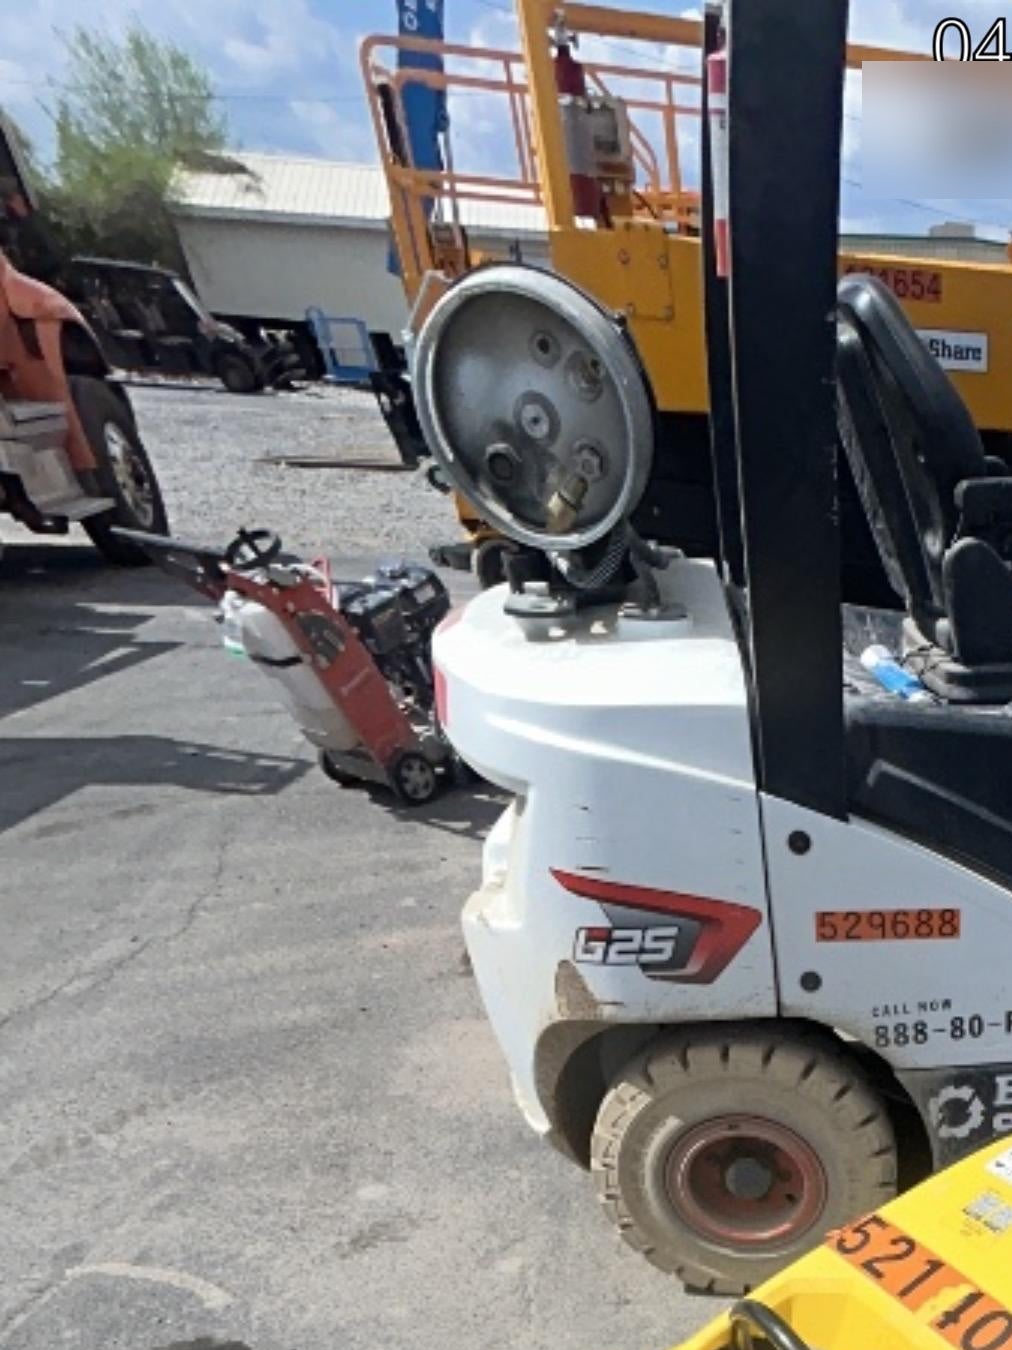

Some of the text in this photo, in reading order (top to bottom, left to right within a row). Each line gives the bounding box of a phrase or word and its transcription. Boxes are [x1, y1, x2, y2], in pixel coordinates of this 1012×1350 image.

[928, 337, 983, 362] Share
[818, 908, 958, 941] 529688
[574, 925, 680, 965] G25
[871, 998, 953, 1019] CALL NOW
